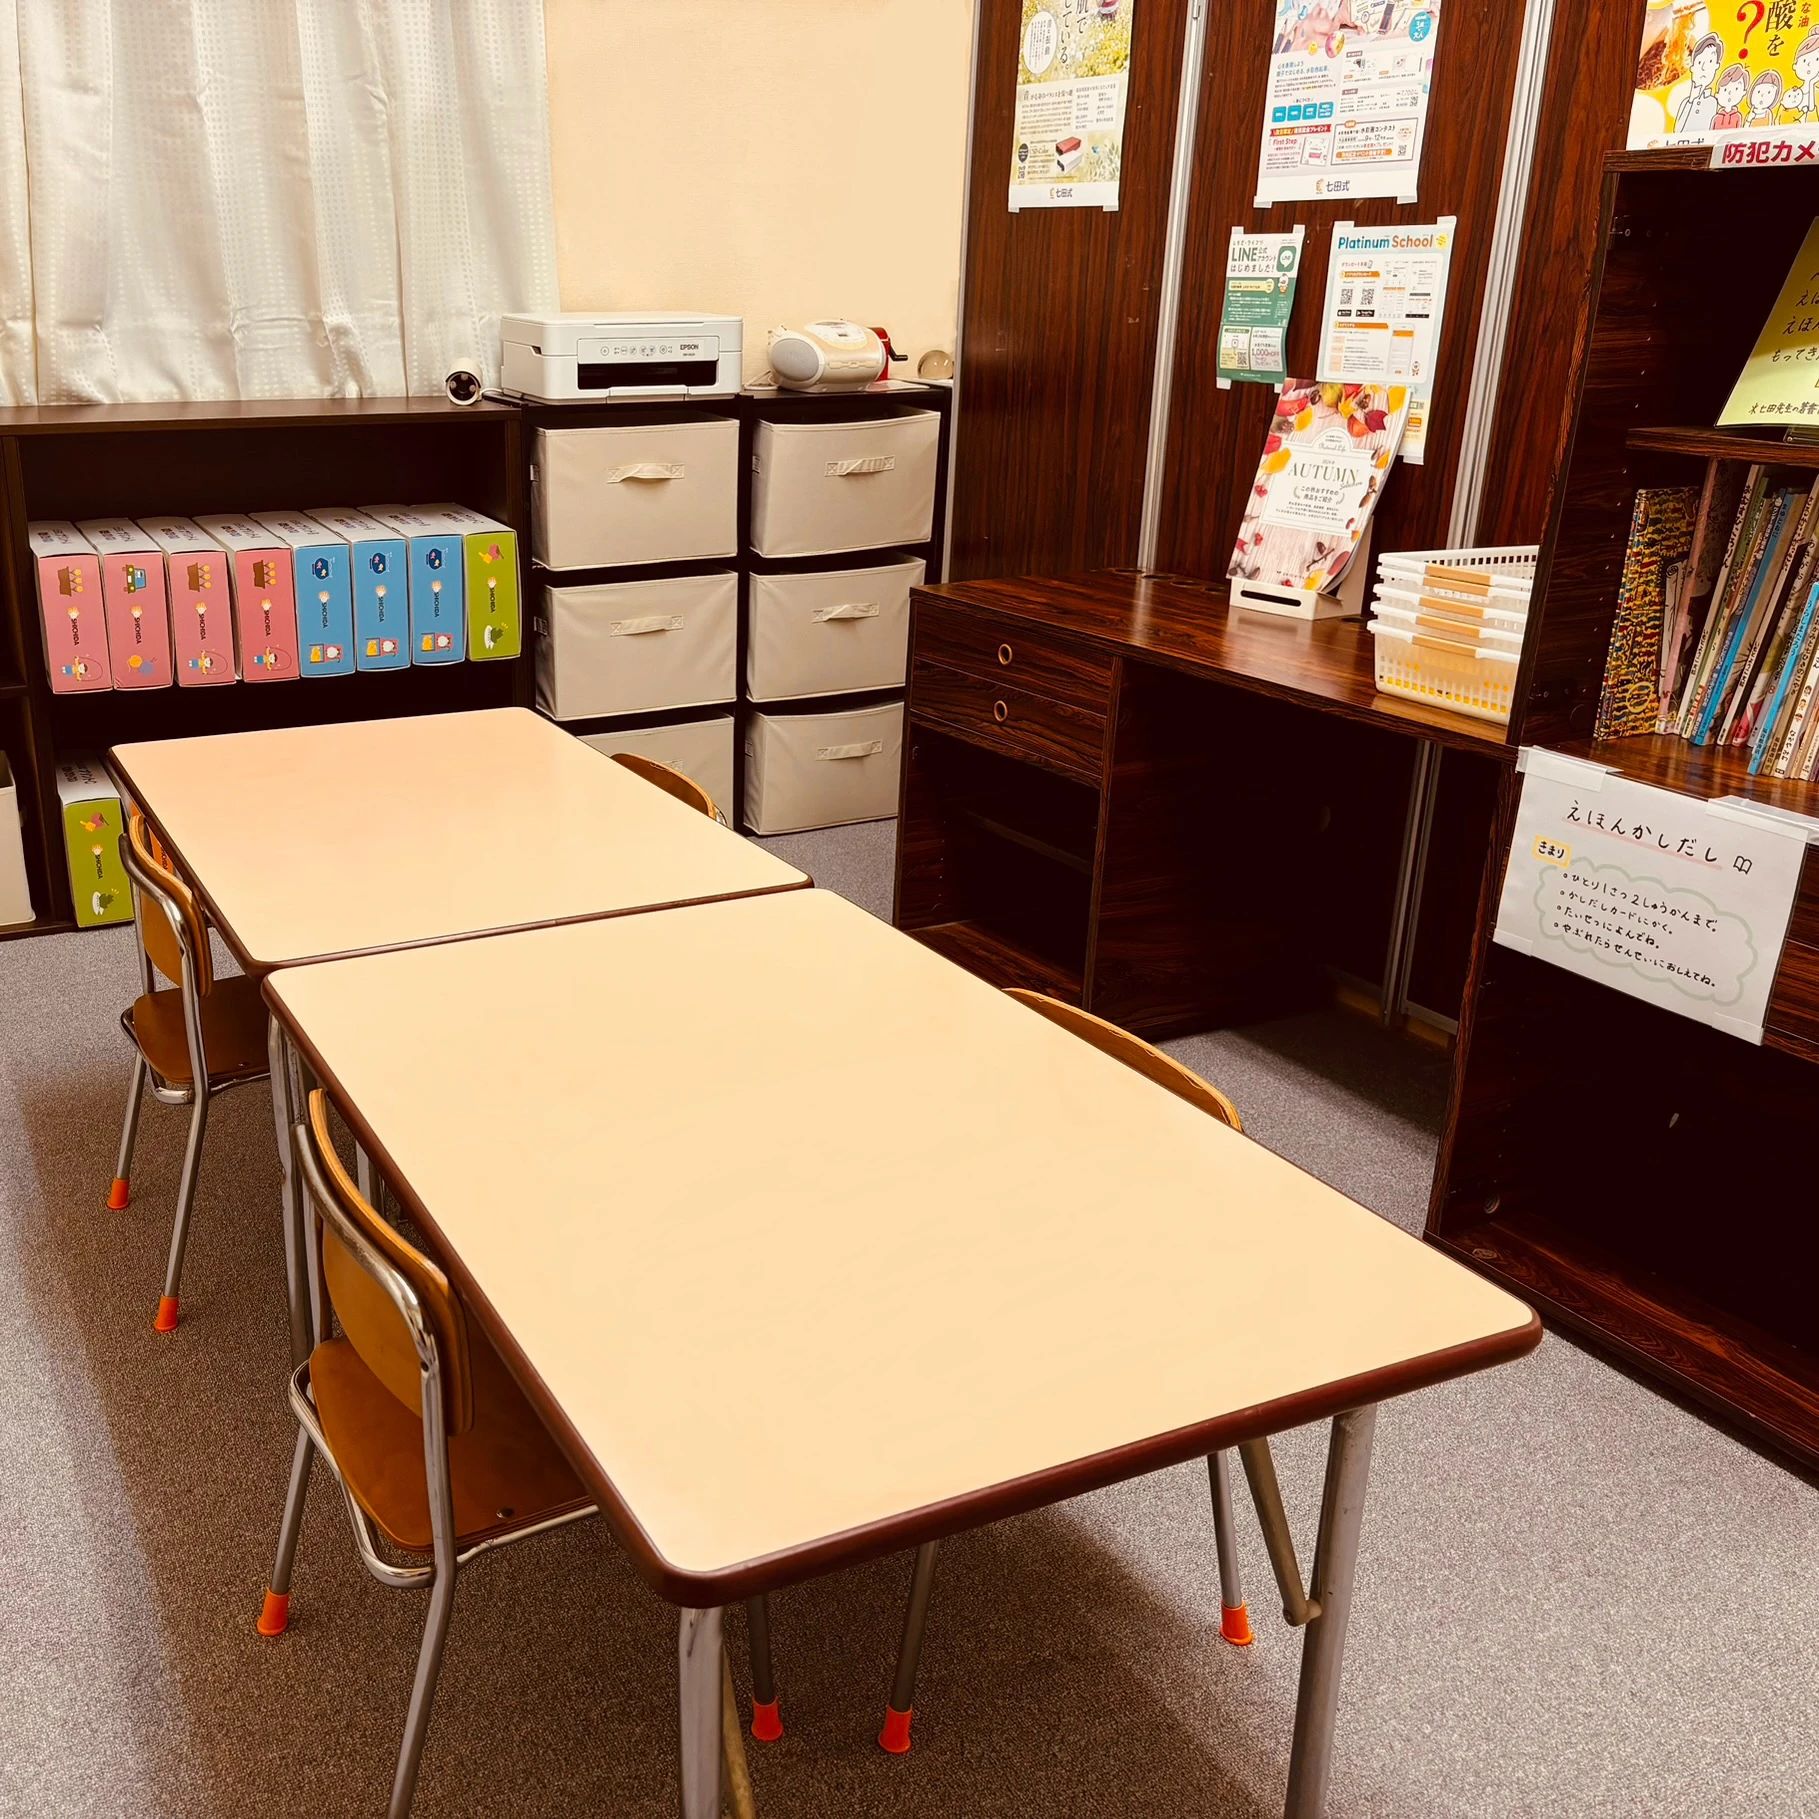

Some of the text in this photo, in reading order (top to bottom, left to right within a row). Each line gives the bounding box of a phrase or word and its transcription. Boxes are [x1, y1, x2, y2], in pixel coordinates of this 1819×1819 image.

[1722, 140, 1819, 164] 防犯カメ
[1326, 180, 1350, 192] 七田式
[1338, 234, 1434, 249] Platinum School
[1232, 247, 1258, 262] LINE
[1231, 264, 1275, 273] はじめました!
[1772, 347, 1819, 362] もってき
[1748, 401, 1819, 415] ※七田先生の著書
[1288, 462, 1359, 485] AUTUMN
[1566, 800, 1718, 863] えほんかしだし
[1537, 840, 1565, 859] きまり
